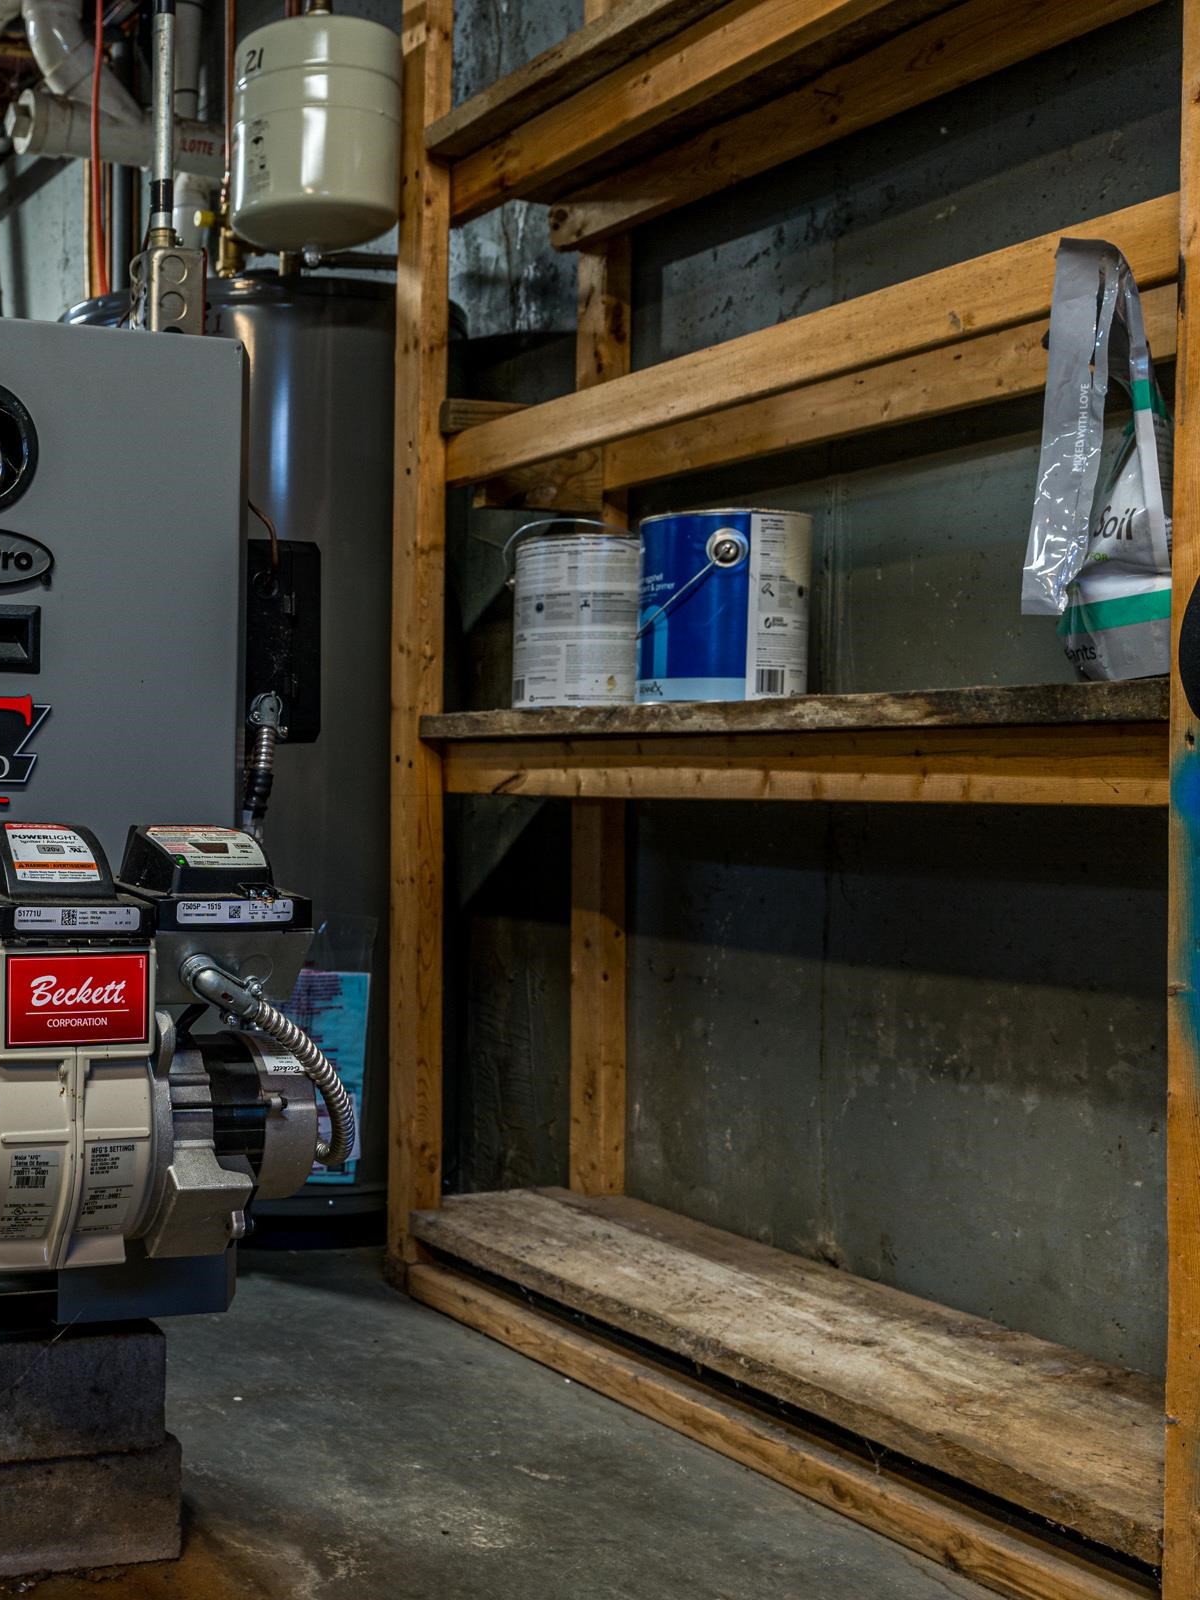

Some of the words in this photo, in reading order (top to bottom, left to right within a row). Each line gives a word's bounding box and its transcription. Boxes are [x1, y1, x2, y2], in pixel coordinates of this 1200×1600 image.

[245, 47, 264, 74] 21
[1080, 384, 1089, 409] LOVE
[1076, 412, 1088, 439] WITH
[1072, 440, 1085, 472] MIXED
[1094, 505, 1136, 540] Soil
[30, 976, 126, 1007] Beckett
[47, 1017, 108, 1028] CORPORATION
[110, 1144, 135, 1152] SETTINGS
